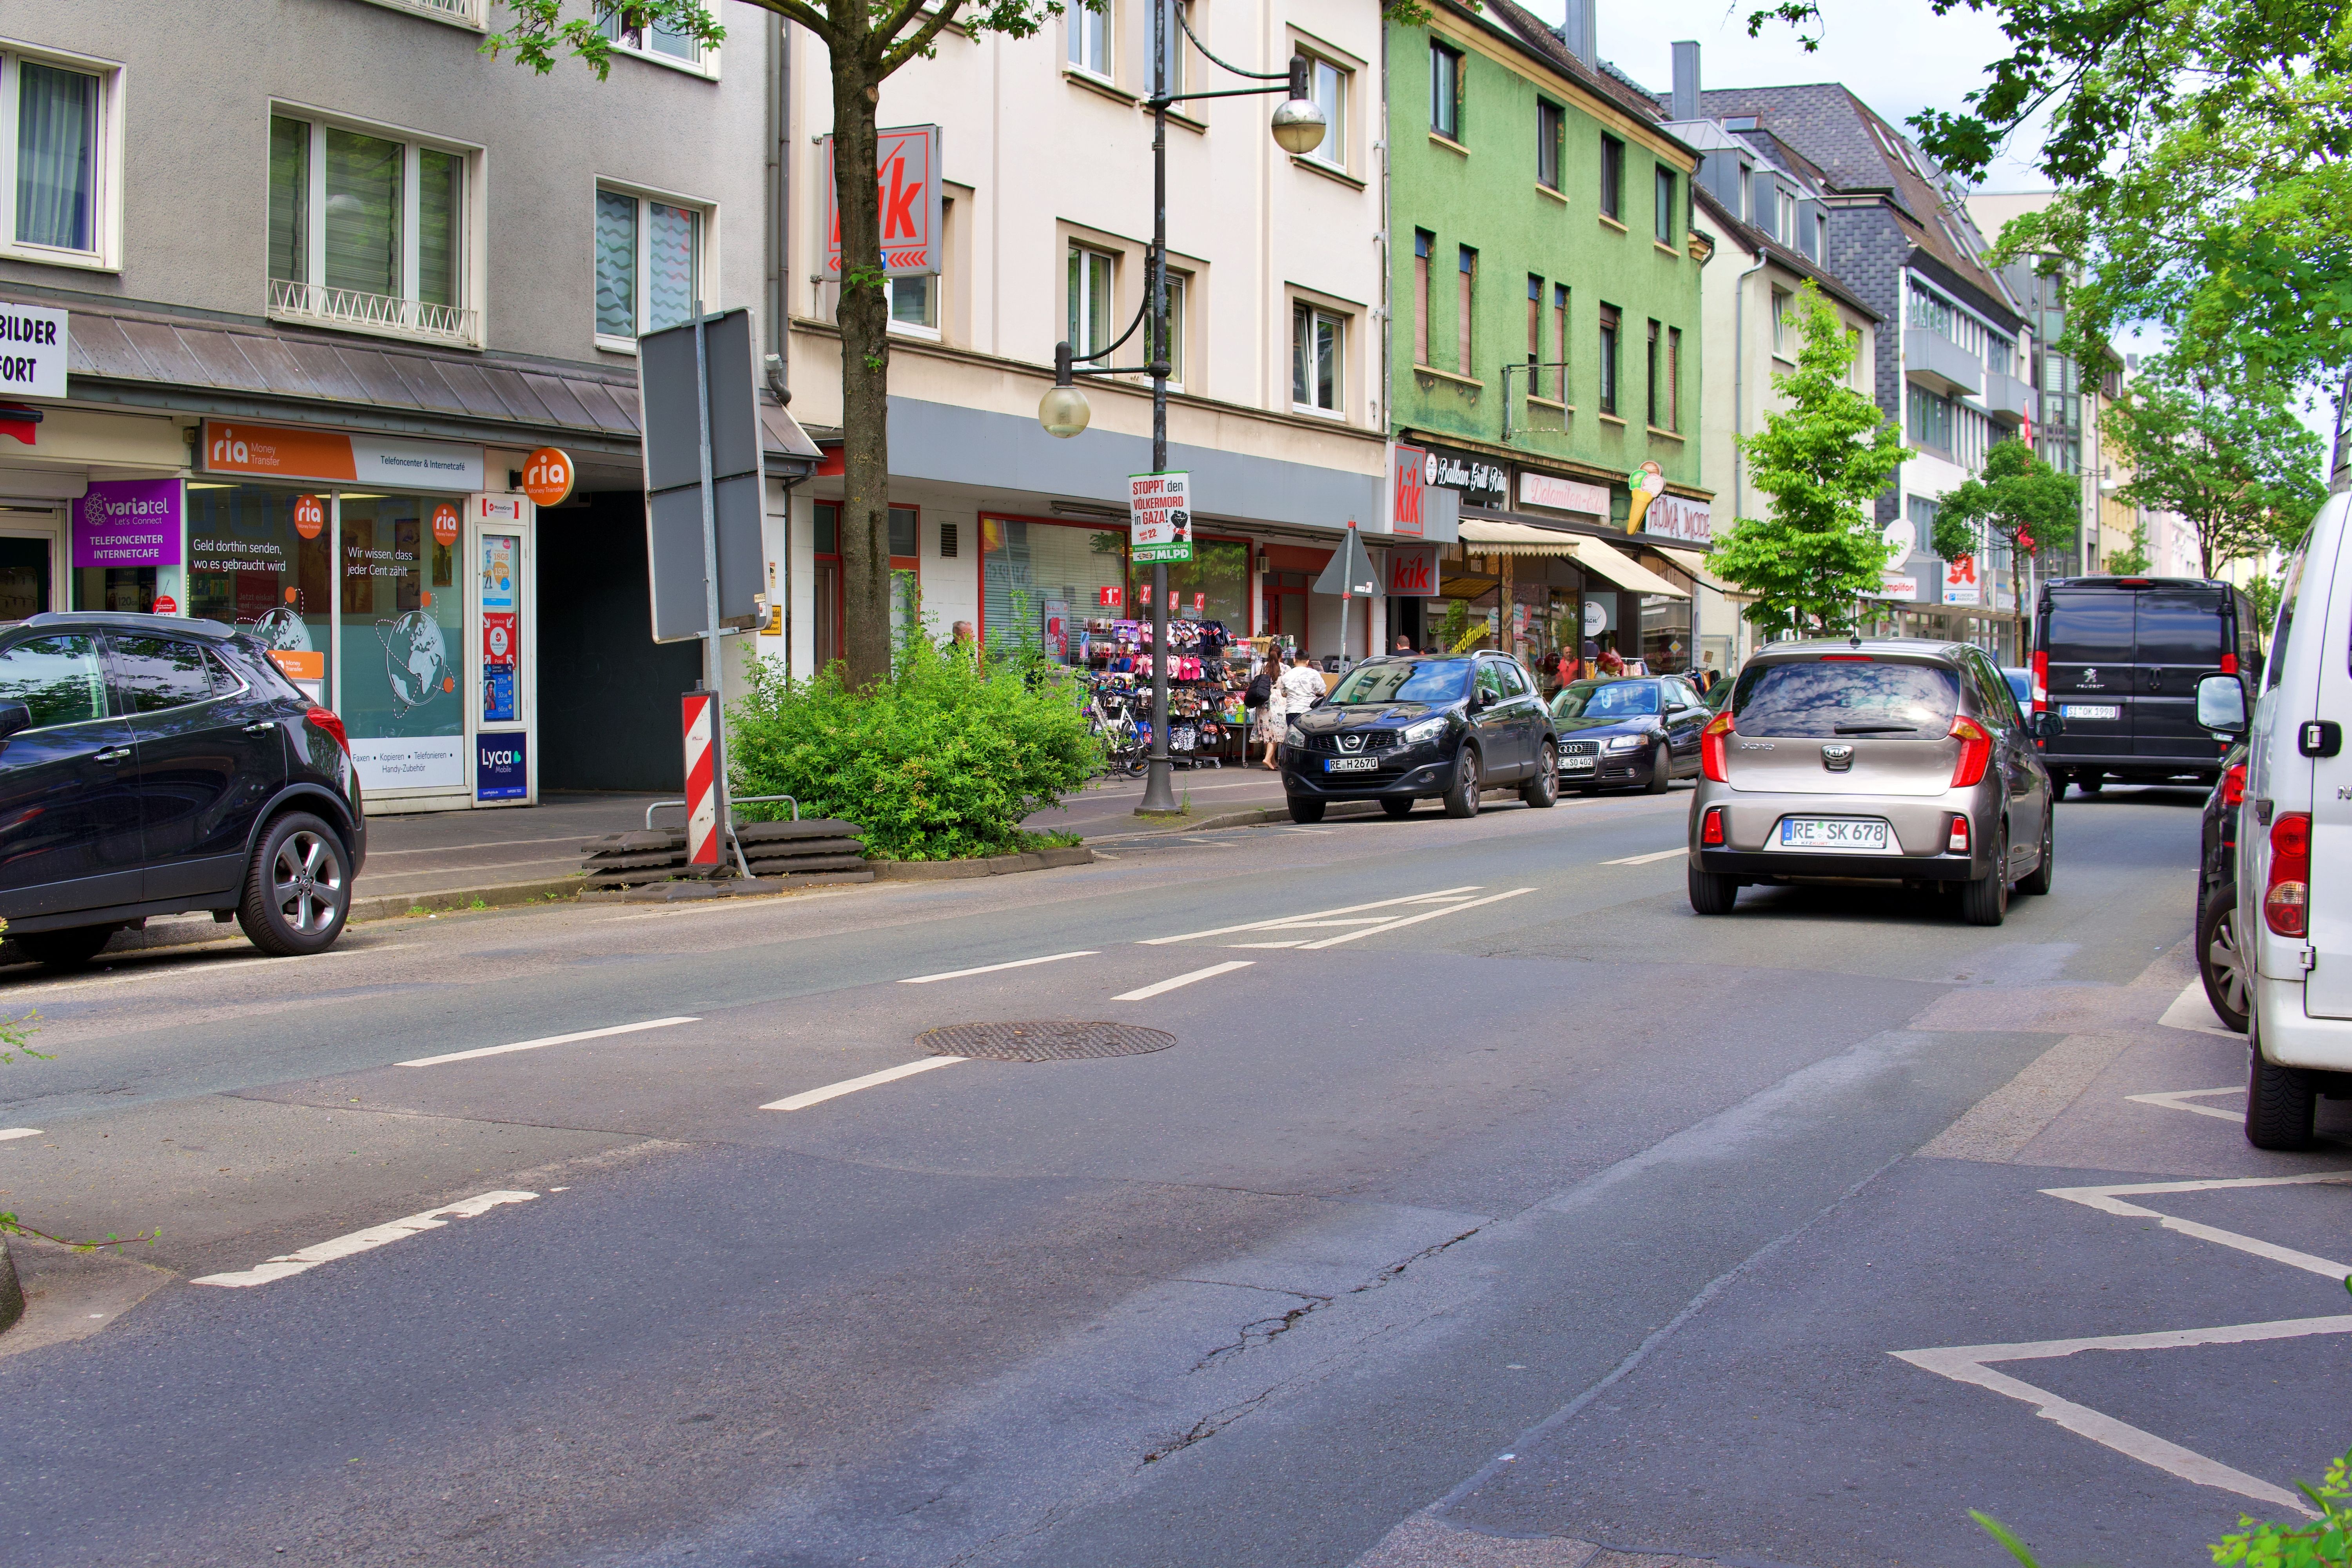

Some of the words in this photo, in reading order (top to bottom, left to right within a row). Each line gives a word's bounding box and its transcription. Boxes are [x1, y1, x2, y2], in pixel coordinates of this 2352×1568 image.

[214, 429, 248, 463] ria
[251, 443, 276, 454] Money
[251, 455, 279, 466] Transfer
[381, 456, 422, 467] Telefoncenter
[430, 460, 465, 470] Internetcafé
[528, 455, 564, 485] ria
[1438, 458, 1470, 486] Balkan
[1471, 463, 1488, 491] Grill
[1489, 467, 1507, 492] Rita
[1133, 480, 1165, 495] STOPPT
[1168, 480, 1183, 492] den
[1396, 457, 1421, 523] kik
[1532, 478, 1603, 513] Dolomiten-Eis
[105, 497, 169, 515] variatel
[1134, 496, 1183, 510] VÖLKERMORD
[298, 500, 320, 522] ria
[1134, 514, 1141, 525] in
[1143, 509, 1168, 524] GAZA!
[436, 509, 456, 530] ria
[1684, 507, 1710, 540] MODE
[90, 535, 163, 545] TELEFONCENTER
[1148, 528, 1157, 538] 22
[94, 549, 159, 559] INTERNETCAFE
[194, 539, 214, 551] Geld
[216, 541, 247, 552] dorthin
[250, 542, 282, 555] senden,
[348, 547, 363, 558] Wir
[365, 548, 393, 561] wissen,
[396, 550, 412, 561] dass
[1157, 549, 1189, 560] MLPD
[223, 559, 265, 572] gebraucht
[267, 560, 285, 572] wird
[347, 565, 367, 576] jeder
[370, 565, 387, 576] Cent
[390, 566, 408, 577] zählt
[1394, 552, 1430, 588] kik
[239, 592, 254, 601] Jetzt
[353, 754, 370, 762] Faxen
[380, 753, 404, 762] Kopieren
[414, 751, 446, 760] Telefonieren
[482, 748, 511, 767] Lyca
[382, 764, 425, 774] Handy-Zubehör
[1330, 760, 1341, 769] RE
[1347, 760, 1352, 768] H
[1354, 759, 1376, 768] 2670
[1794, 823, 1814, 838] RE
[1827, 824, 1849, 840] SK
[1853, 824, 1883, 841] 678
